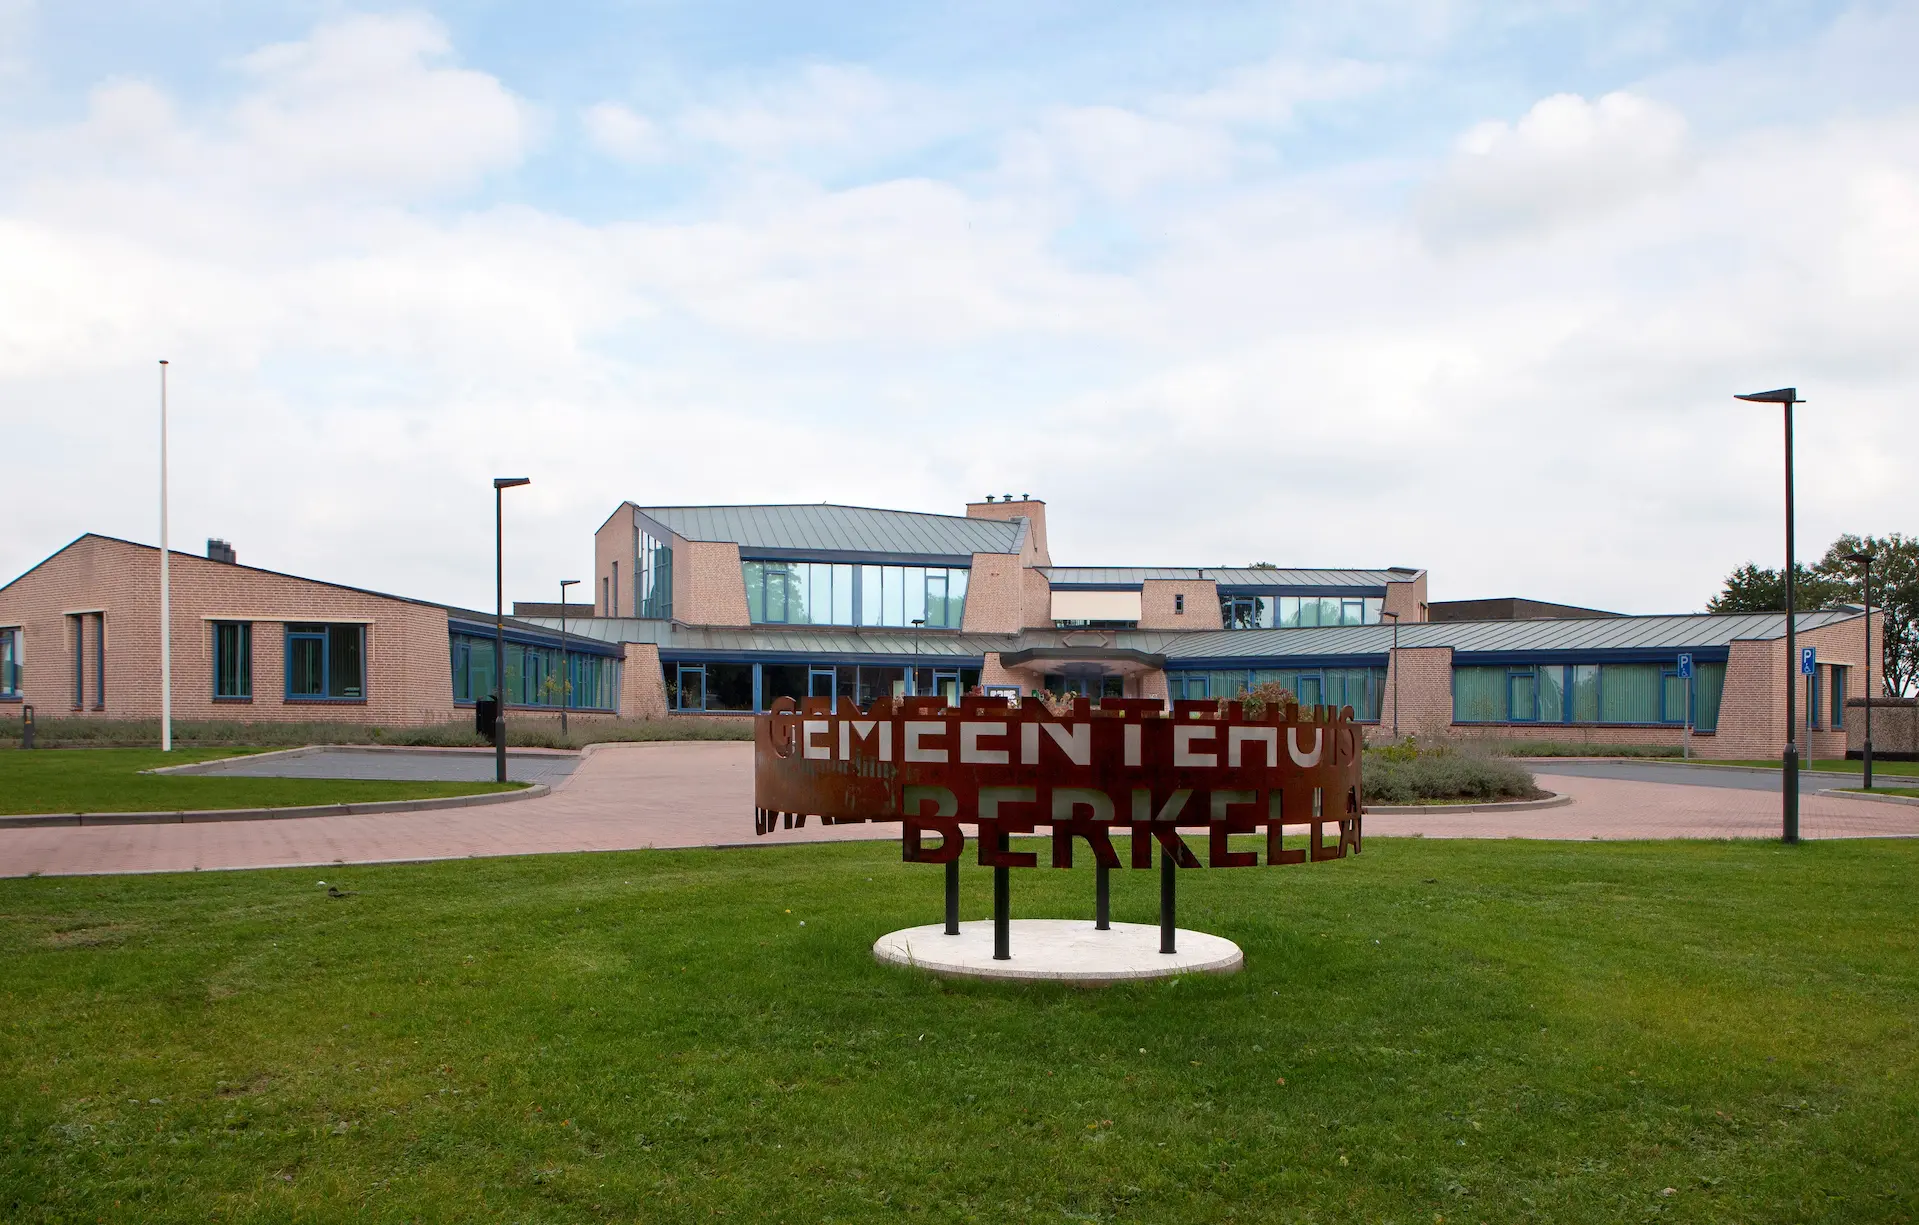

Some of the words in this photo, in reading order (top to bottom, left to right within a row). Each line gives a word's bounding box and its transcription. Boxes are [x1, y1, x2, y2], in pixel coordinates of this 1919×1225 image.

[1680, 656, 1688, 668] P
[1804, 649, 1812, 663] P
[770, 696, 1356, 768] GEMEENTEHUIS
